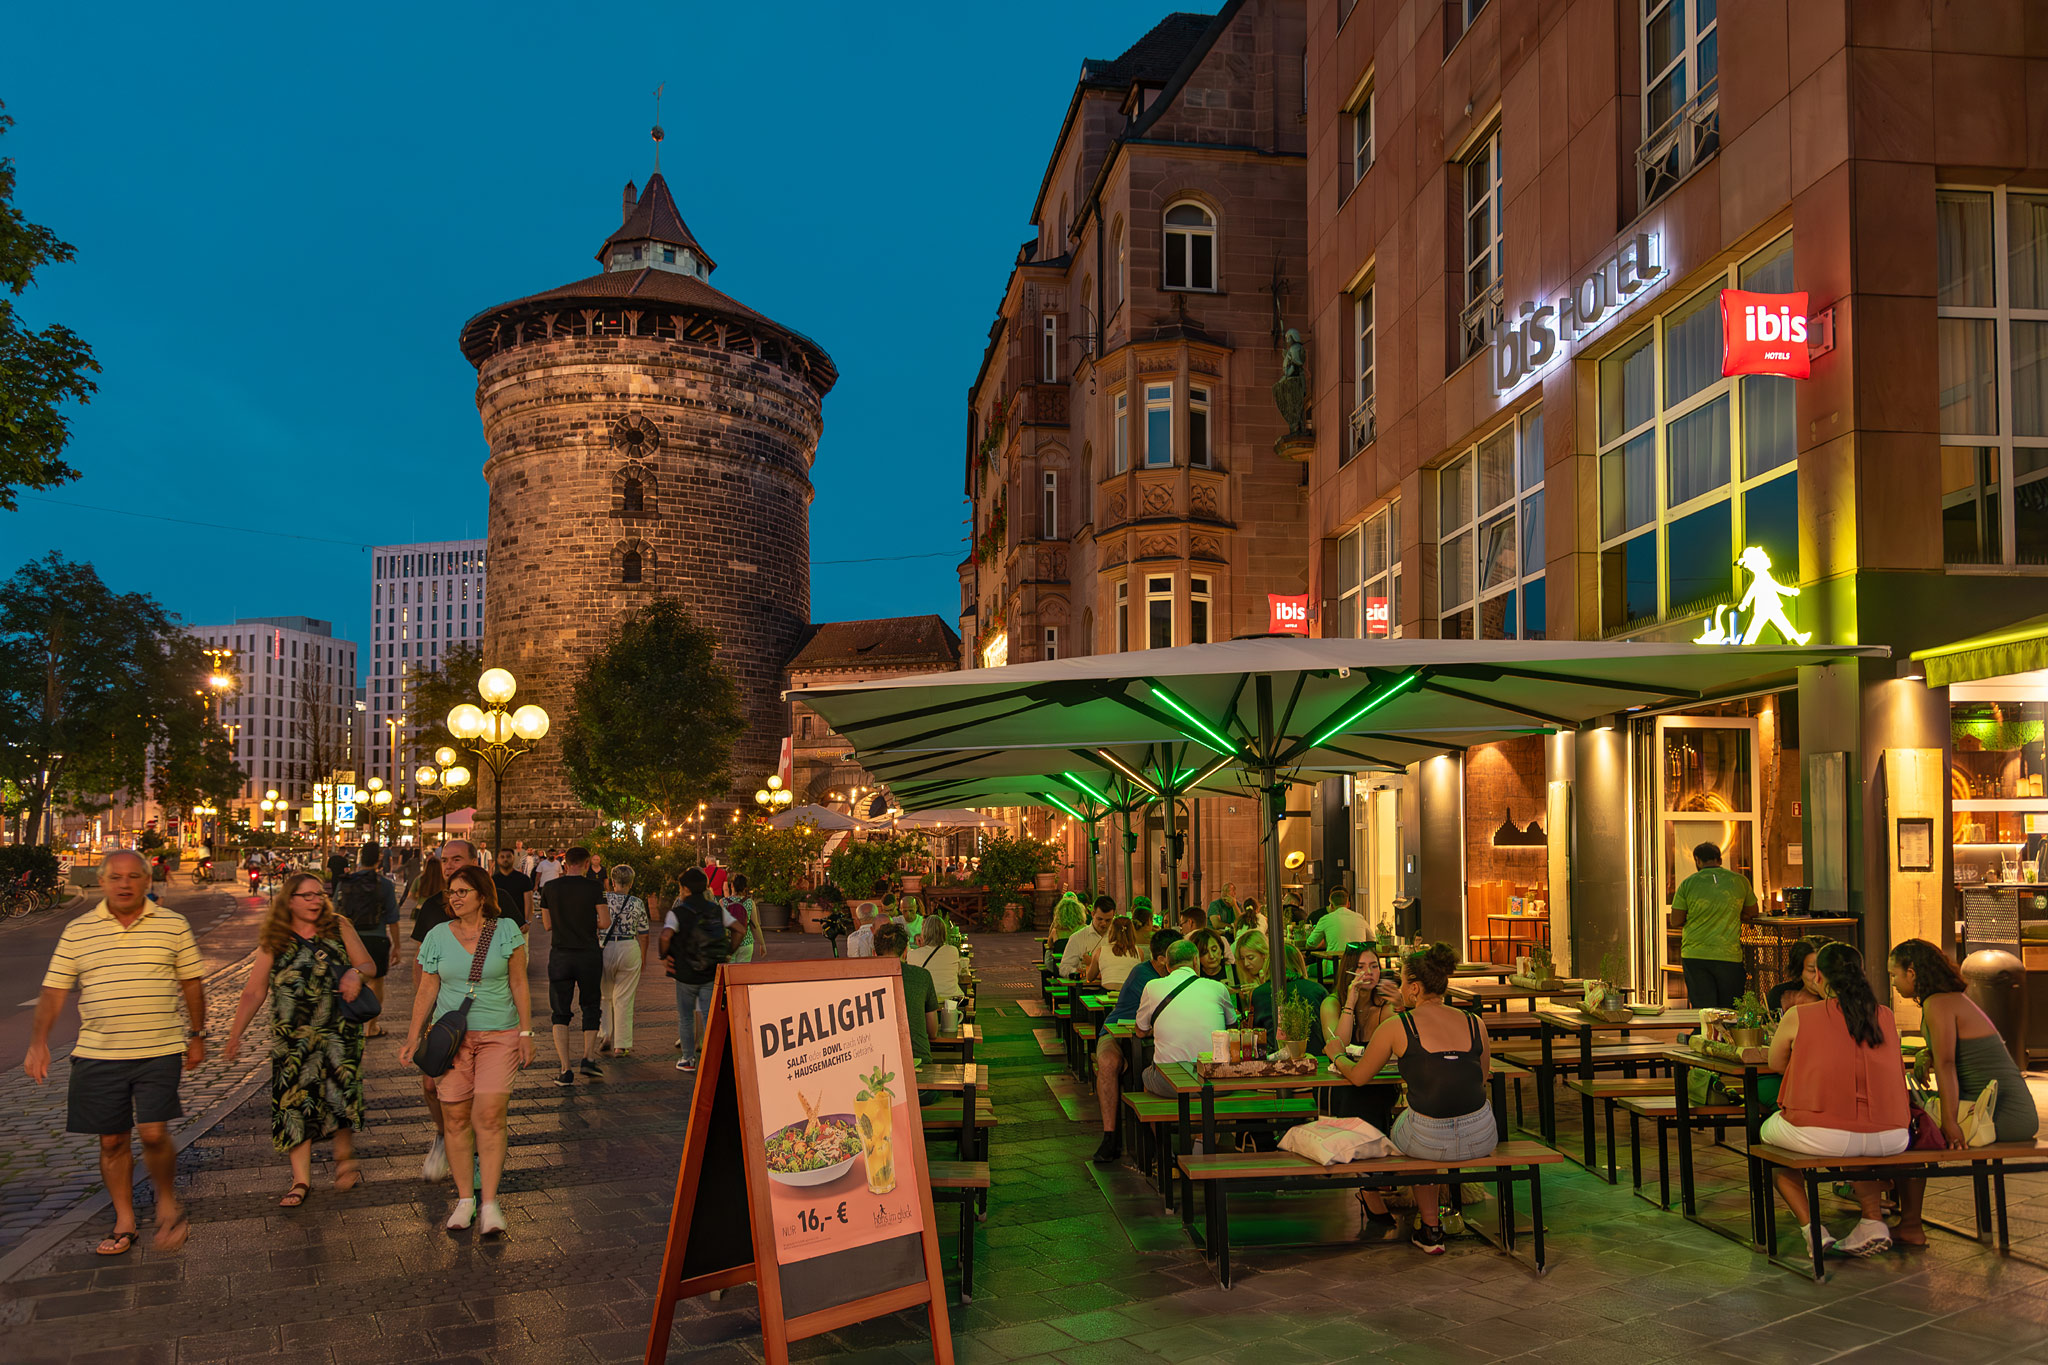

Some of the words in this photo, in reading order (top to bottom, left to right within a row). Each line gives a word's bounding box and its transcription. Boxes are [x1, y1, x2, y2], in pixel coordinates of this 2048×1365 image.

[1560, 233, 1662, 340] HOTEL
[1745, 305, 1808, 343] ibis
[1764, 352, 1791, 360] HOTELS
[1276, 602, 1306, 620] ibis
[760, 988, 886, 1058] DEALIGHT
[786, 1053, 808, 1070] SALAT
[822, 1042, 843, 1057] BOWL
[794, 1051, 853, 1079] HAUSGEMACHTES
[782, 1224, 797, 1238] NUR
[837, 1201, 849, 1224] €
